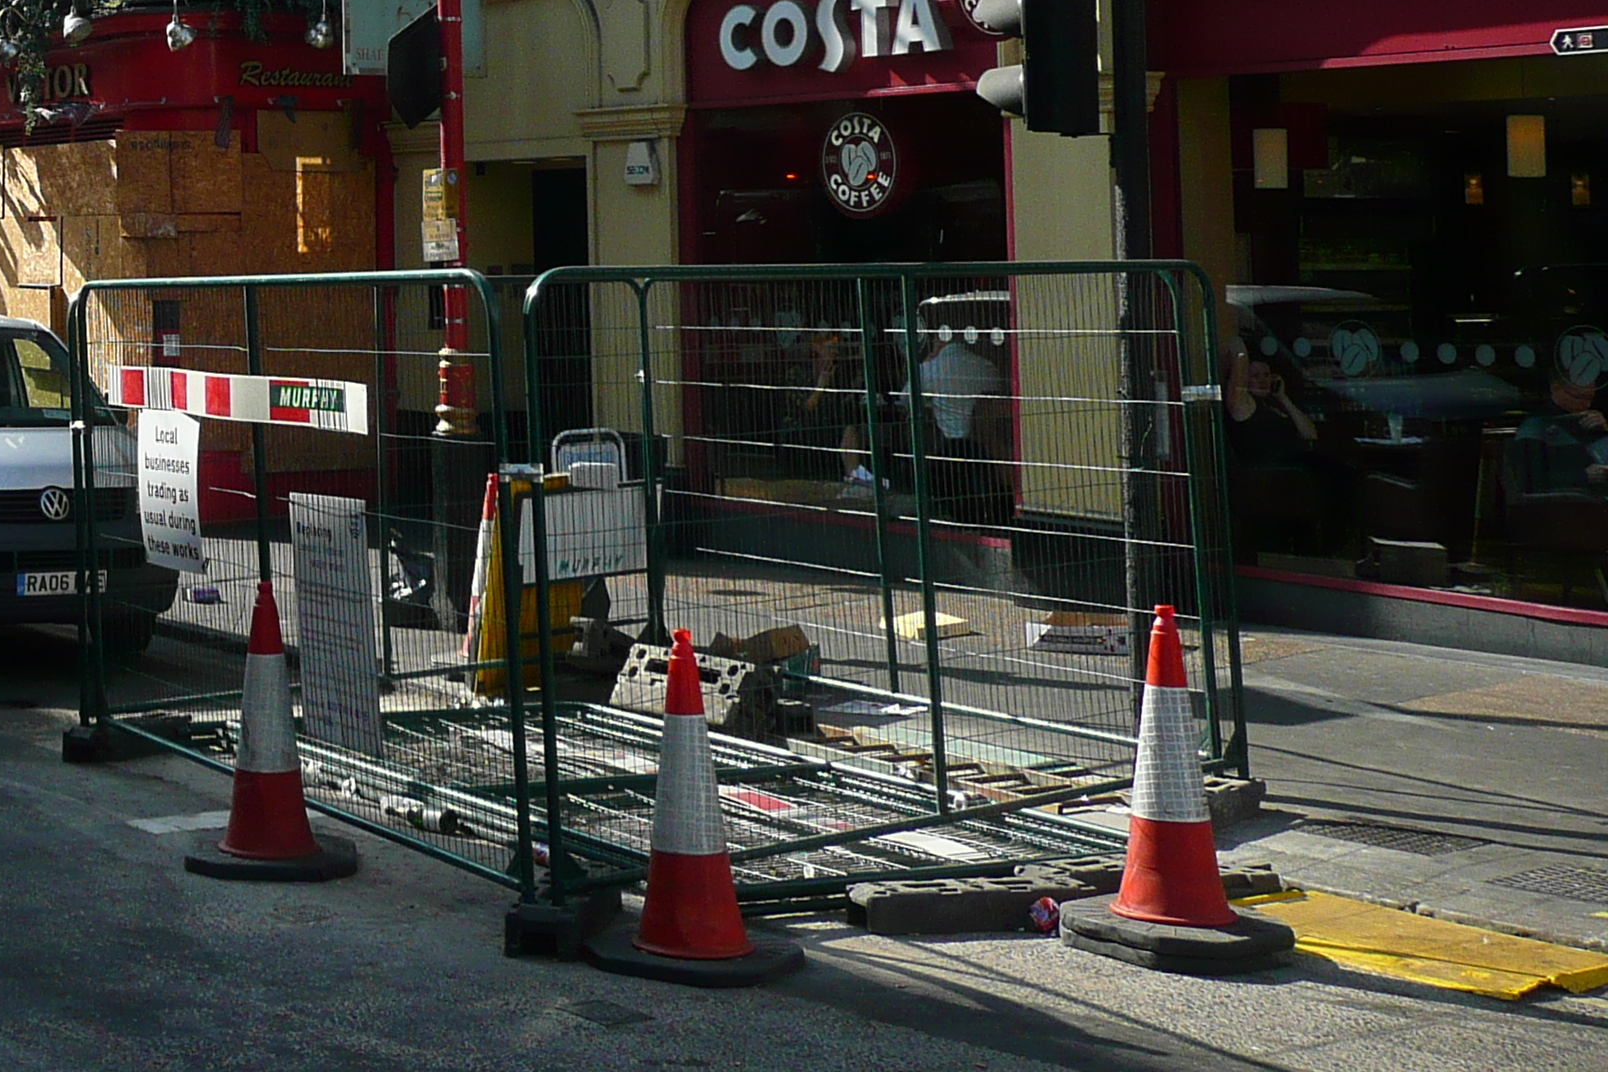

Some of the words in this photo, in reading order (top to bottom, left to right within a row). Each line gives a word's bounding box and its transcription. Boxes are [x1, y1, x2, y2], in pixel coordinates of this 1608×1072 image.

[831, 116, 882, 147] COSTA
[830, 171, 891, 207] COFFEE
[279, 386, 338, 410] MURPHY
[154, 425, 178, 445] Local
[144, 452, 190, 475] businesses
[147, 480, 177, 505] trading
[178, 488, 189, 503] as
[144, 510, 166, 529] usual
[168, 510, 196, 536] during
[147, 534, 171, 556] these
[172, 541, 200, 561] works
[27, 574, 70, 593] RA06
